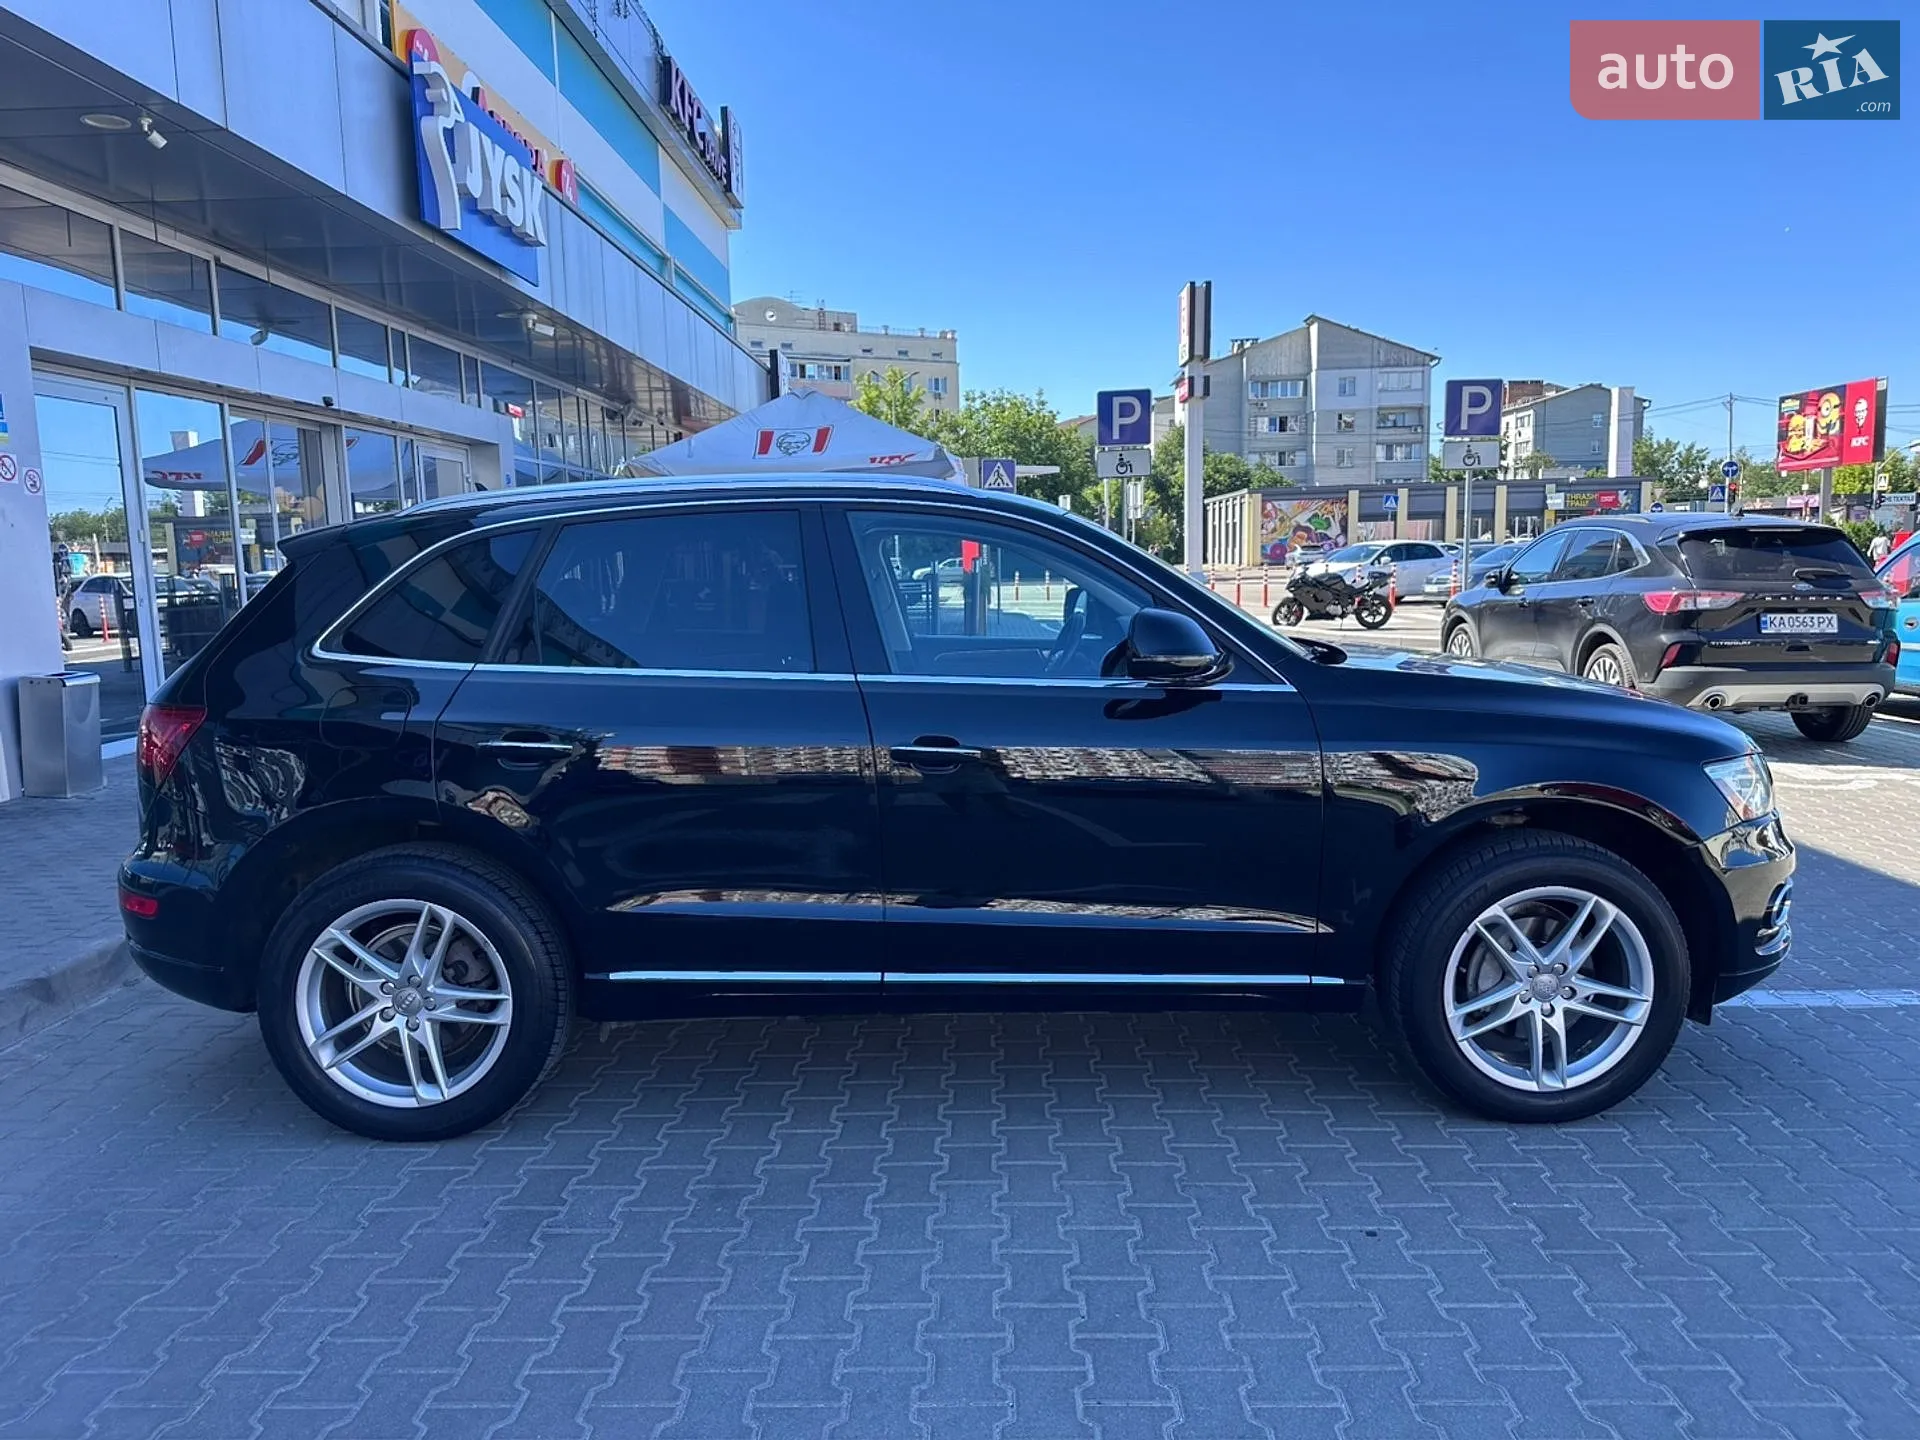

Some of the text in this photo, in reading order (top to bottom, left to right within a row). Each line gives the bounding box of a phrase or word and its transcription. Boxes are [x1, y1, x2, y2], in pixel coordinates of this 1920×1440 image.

[669, 57, 704, 151] KFC
[458, 122, 547, 247] JYSK
[1112, 395, 1142, 440] P
[1461, 385, 1492, 431] P
[1850, 436, 1870, 448] KFC
[1769, 616, 1834, 628] KA 0563 PX
